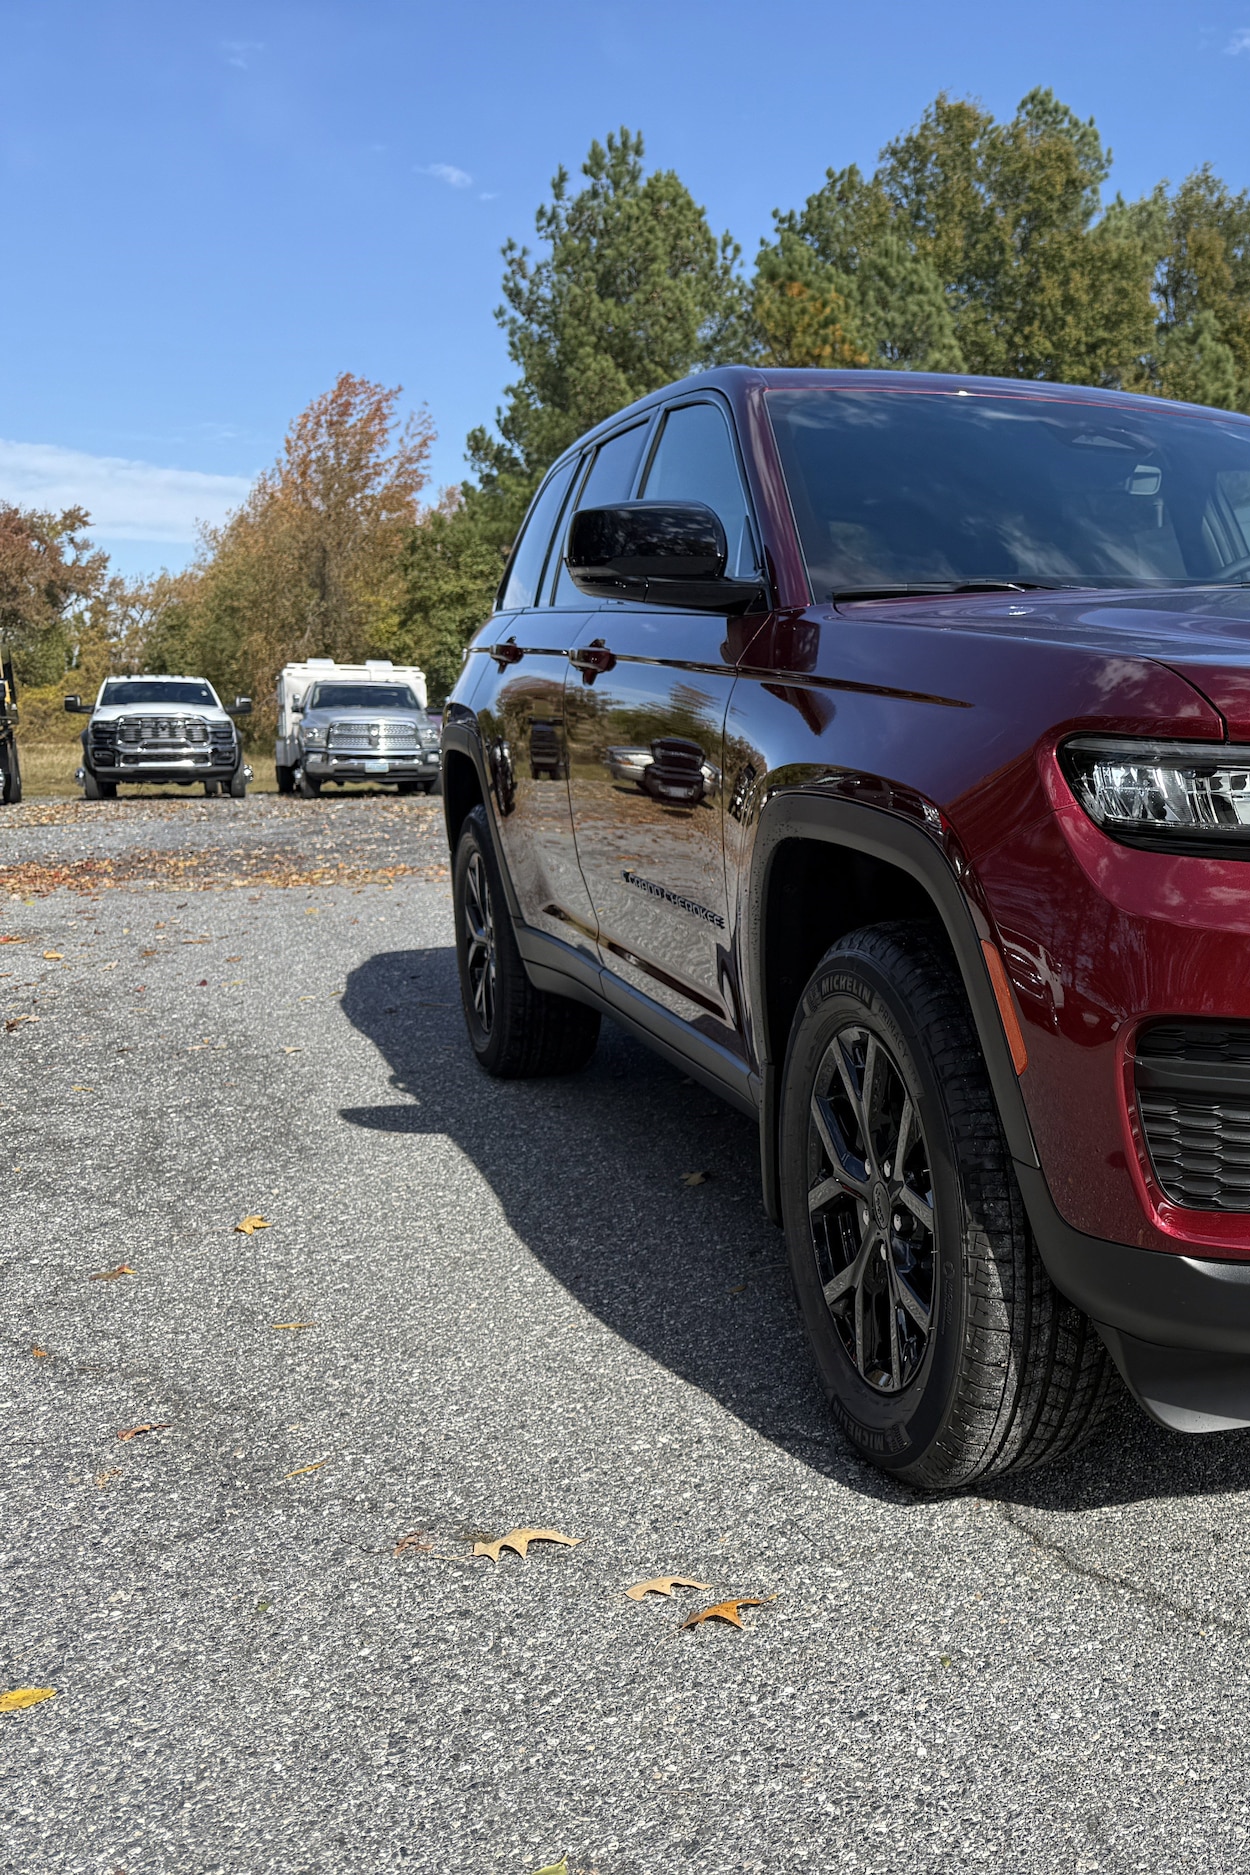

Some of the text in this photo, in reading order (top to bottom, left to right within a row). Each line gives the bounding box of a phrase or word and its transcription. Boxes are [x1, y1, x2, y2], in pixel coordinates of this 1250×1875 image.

[665, 889, 726, 930] CHEROKEE
[821, 974, 871, 1004] MICHELIN
[878, 1004, 909, 1058] PRIMACY
[832, 1400, 885, 1452] MICHELIN
